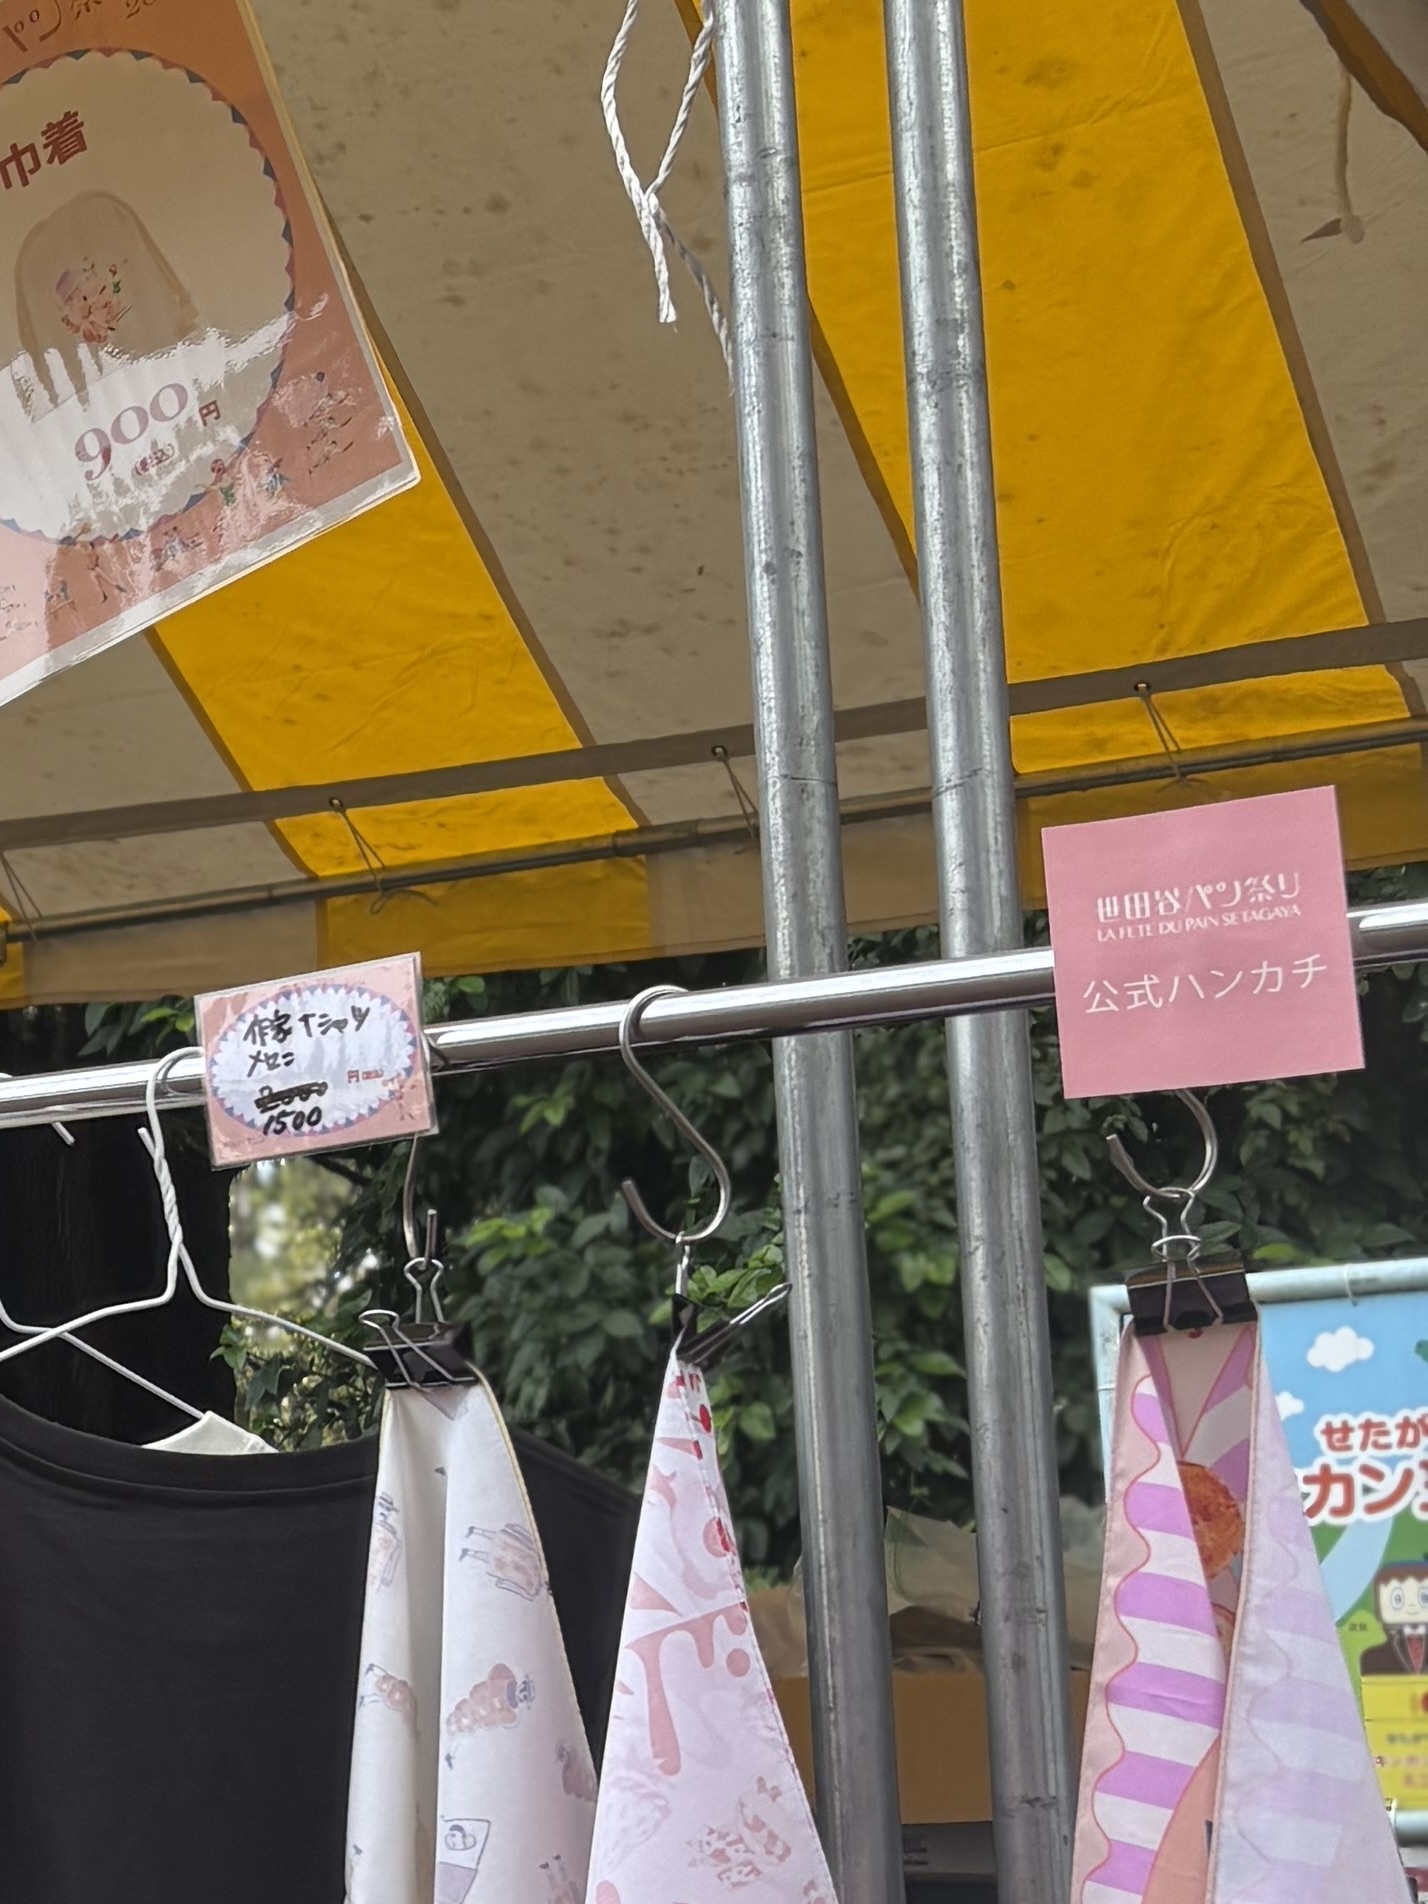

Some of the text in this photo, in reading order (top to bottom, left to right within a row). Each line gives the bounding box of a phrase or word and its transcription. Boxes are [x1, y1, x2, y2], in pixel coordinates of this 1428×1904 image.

[1097, 872, 1300, 923] 世田谷パン祭り
[1159, 917, 1183, 935] DU
[1185, 913, 1219, 932] PAIN
[1222, 904, 1301, 927] SETAGAYA
[1083, 954, 1328, 1016] 公式ハンカチ
[263, 1106, 322, 1135] 1500
